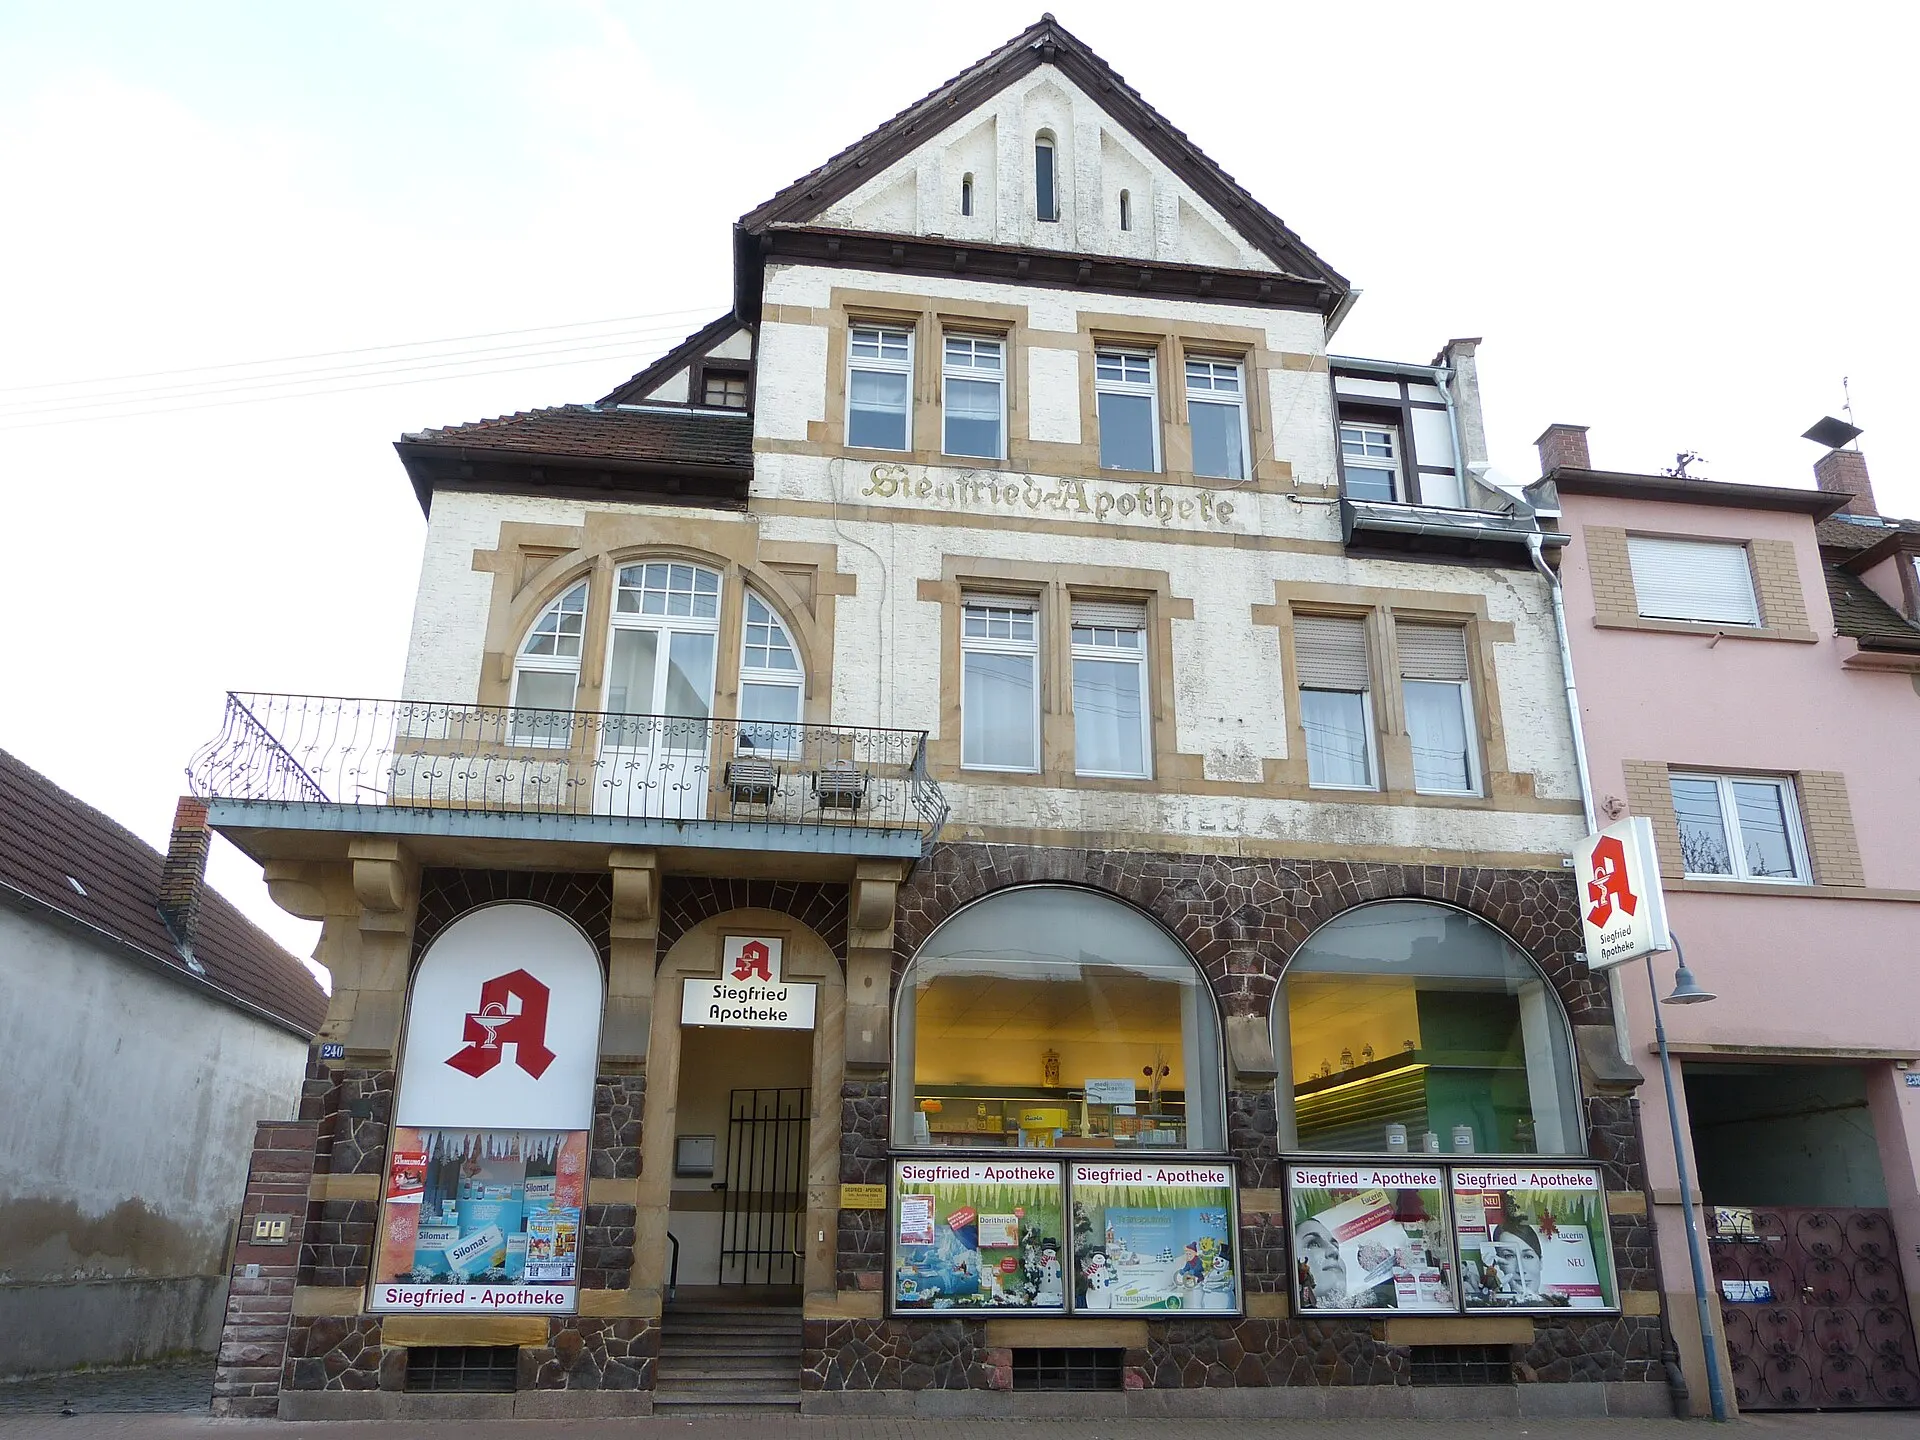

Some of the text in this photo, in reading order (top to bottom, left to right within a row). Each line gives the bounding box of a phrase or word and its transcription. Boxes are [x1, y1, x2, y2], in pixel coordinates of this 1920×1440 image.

[1600, 924, 1632, 945] Siegfried
[1601, 940, 1635, 959] Apotheke
[712, 985, 788, 1003] Siegfried
[709, 1004, 788, 1022] Apotheke
[323, 1045, 344, 1058] 240
[900, 1166, 970, 1183] Siegfried
[984, 1167, 1055, 1183] Apotheke
[1077, 1167, 1142, 1184] Siegfried
[1156, 1169, 1225, 1185] Apotheke
[1296, 1171, 1358, 1187] Siegfried
[1371, 1172, 1437, 1187] Apotheke
[1457, 1173, 1517, 1188] Siegfried
[1530, 1173, 1593, 1189] Apotheke
[525, 1183, 550, 1193] Silomat
[1361, 1191, 1384, 1205] Eucerin
[419, 1231, 449, 1240] Silomat
[453, 1235, 488, 1260] Silomat
[1567, 1259, 1585, 1267] NEU
[385, 1288, 465, 1308] Siegfried
[480, 1289, 565, 1309] Apotheke
[1115, 1294, 1163, 1303] Transpulmin
